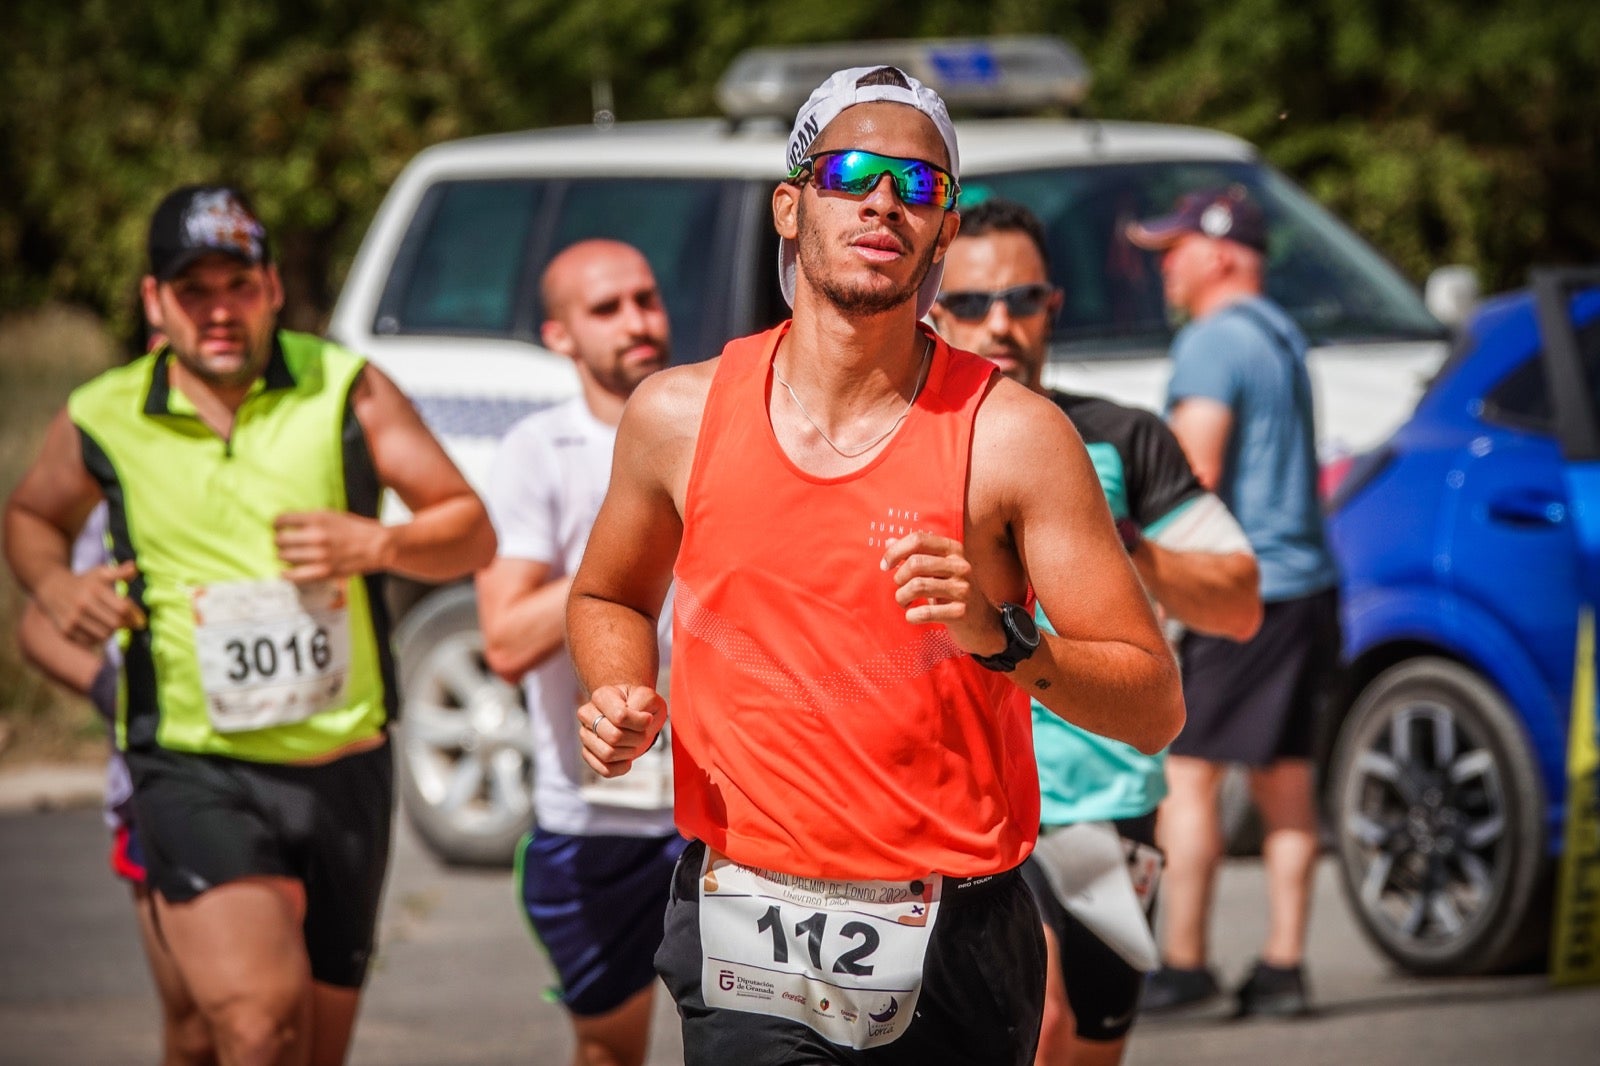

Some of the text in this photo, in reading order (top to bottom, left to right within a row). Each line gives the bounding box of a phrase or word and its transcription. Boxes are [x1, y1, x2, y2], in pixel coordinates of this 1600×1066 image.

[888, 507, 919, 521] NIKE
[225, 626, 332, 683] 3016
[792, 873, 826, 894] PREMIO
[828, 883, 842, 896] DE
[844, 882, 877, 902] FONDO
[878, 886, 908, 903] 2022
[756, 905, 881, 977] 112
[737, 976, 775, 989] Diputación
[745, 985, 775, 995] Granada
